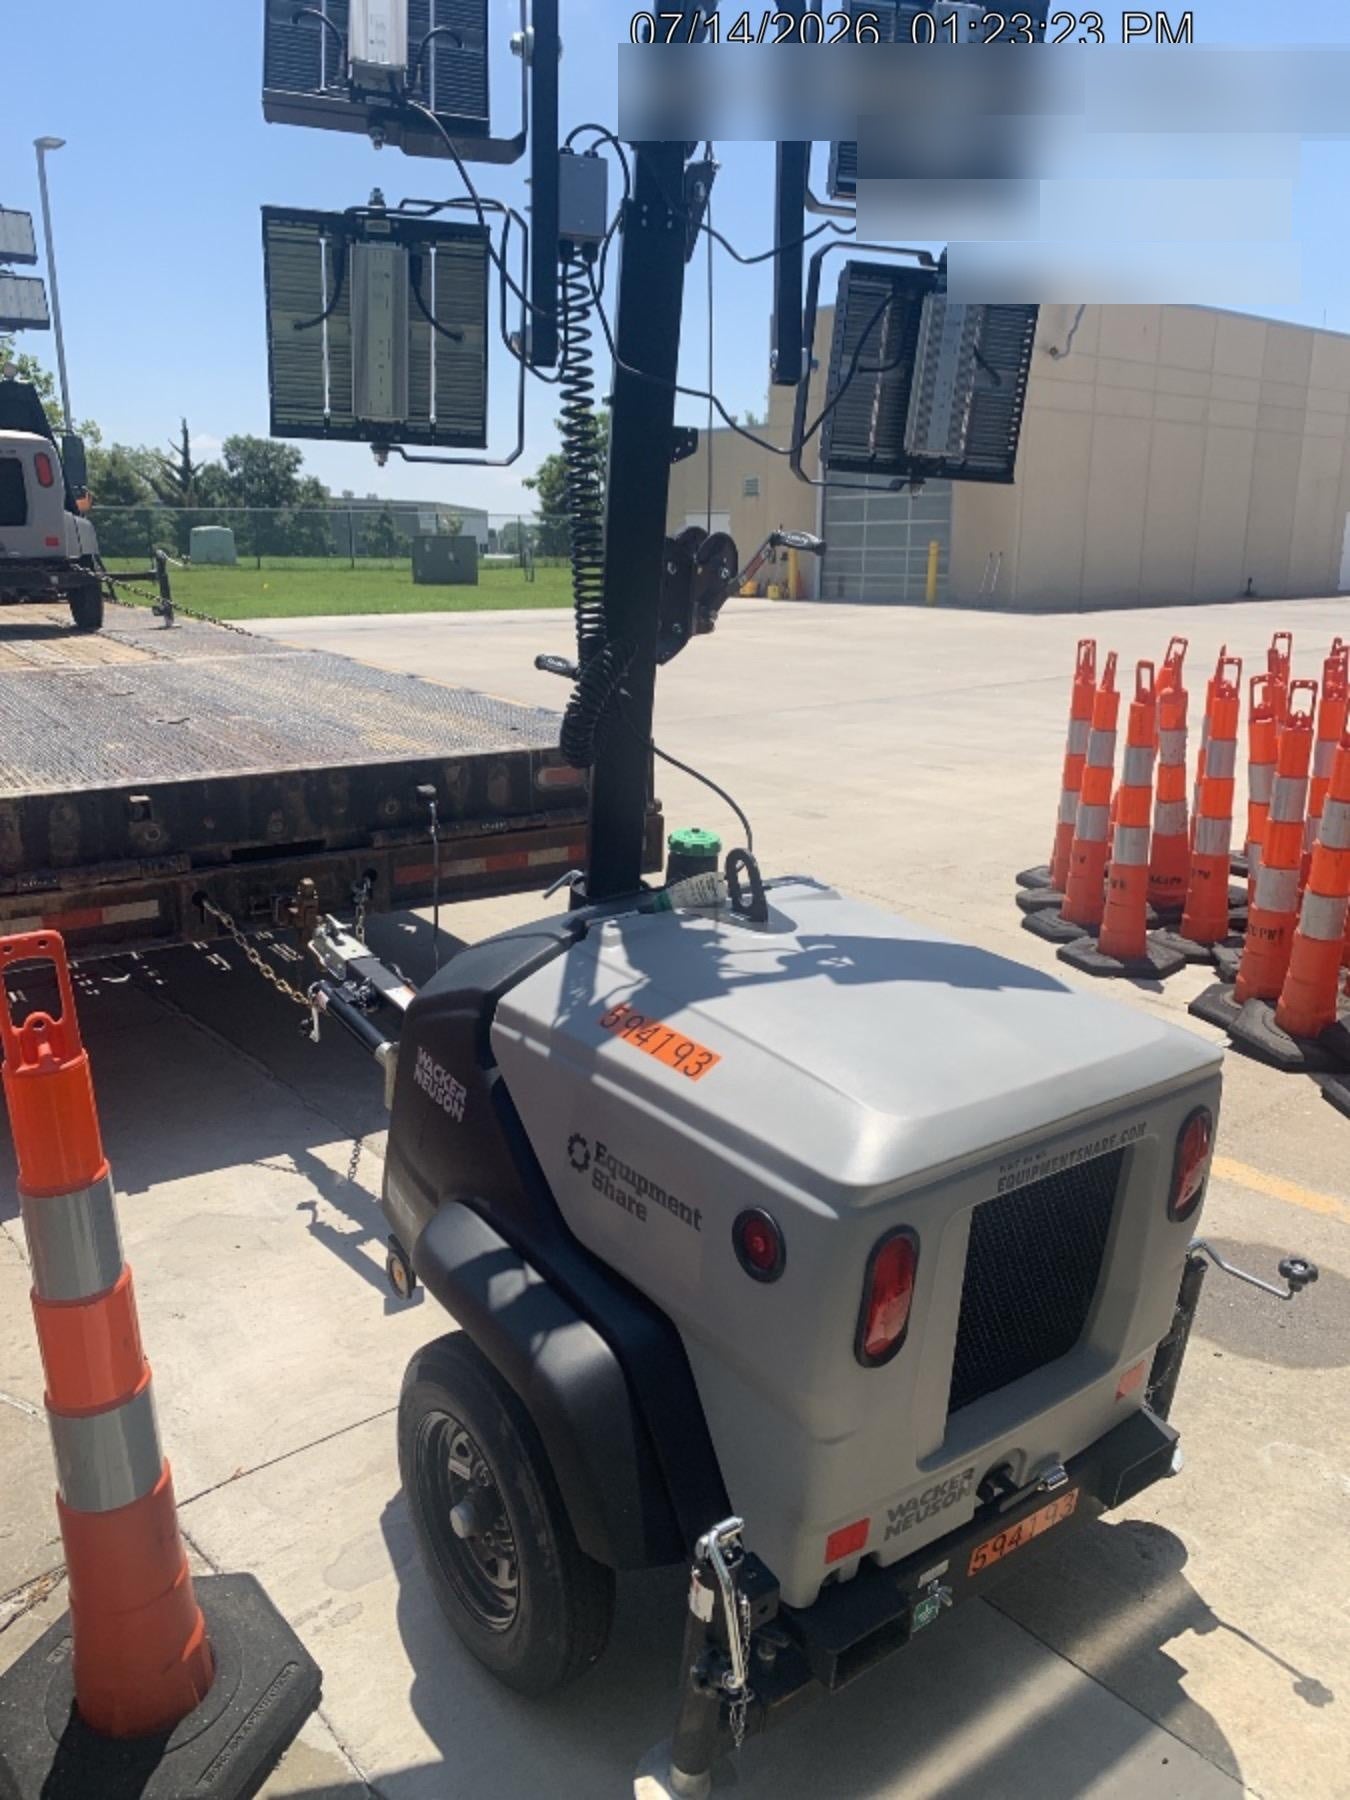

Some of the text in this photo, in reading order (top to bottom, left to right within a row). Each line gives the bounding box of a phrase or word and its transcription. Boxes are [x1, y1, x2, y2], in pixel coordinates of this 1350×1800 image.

[600, 1003, 714, 1078] 594193
[413, 1063, 465, 1123] NEUSON
[417, 1046, 467, 1105] WACKER
[592, 1167, 648, 1222] Share
[594, 1141, 702, 1232] Equipment
[883, 1481, 975, 1542] NEUSON
[886, 1467, 975, 1522] WACKER
